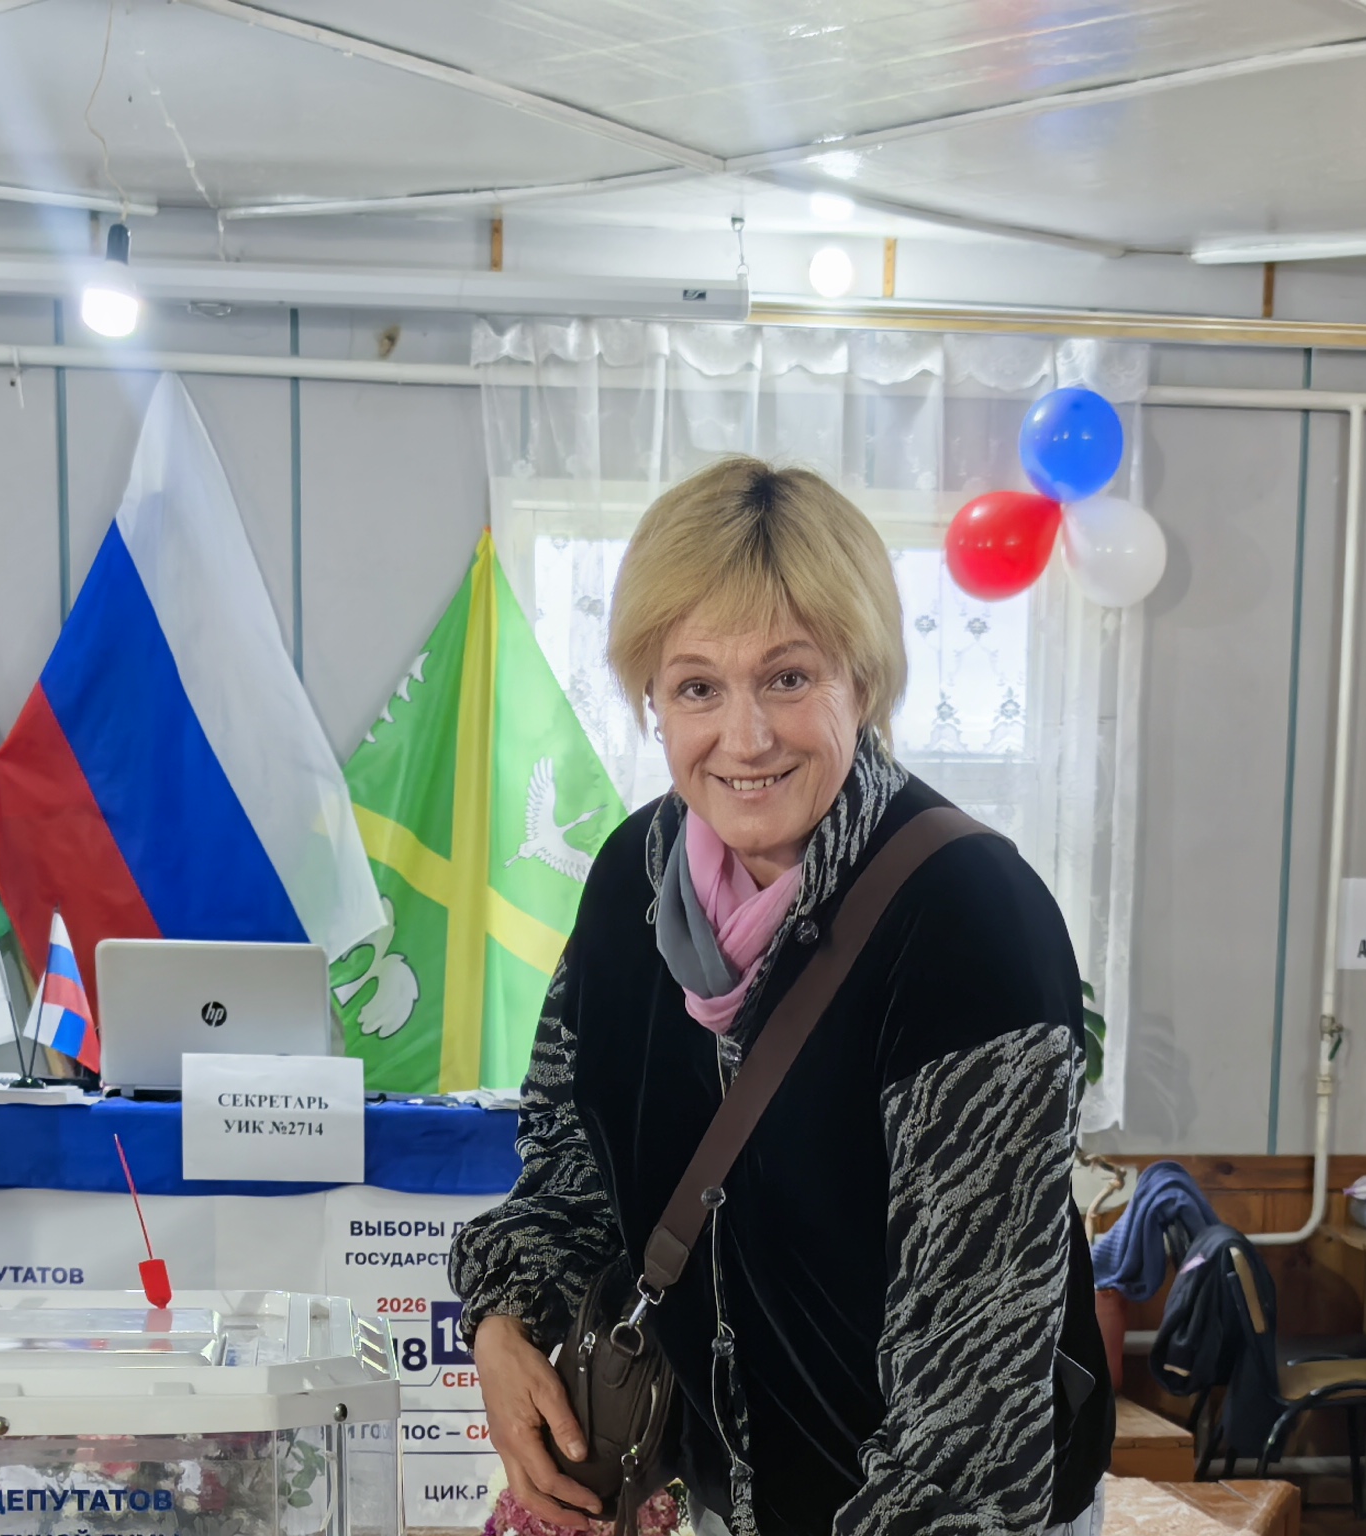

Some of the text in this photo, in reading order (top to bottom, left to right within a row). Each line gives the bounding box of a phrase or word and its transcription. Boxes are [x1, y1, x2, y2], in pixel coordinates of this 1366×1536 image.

[202, 1001, 227, 1028] hp
[217, 1092, 329, 1110] СЕКРЕТАРЬ
[223, 1118, 324, 1136] УИК №2714
[349, 1220, 446, 1237] ВЫБОРЫ
[376, 1297, 427, 1313] 2026
